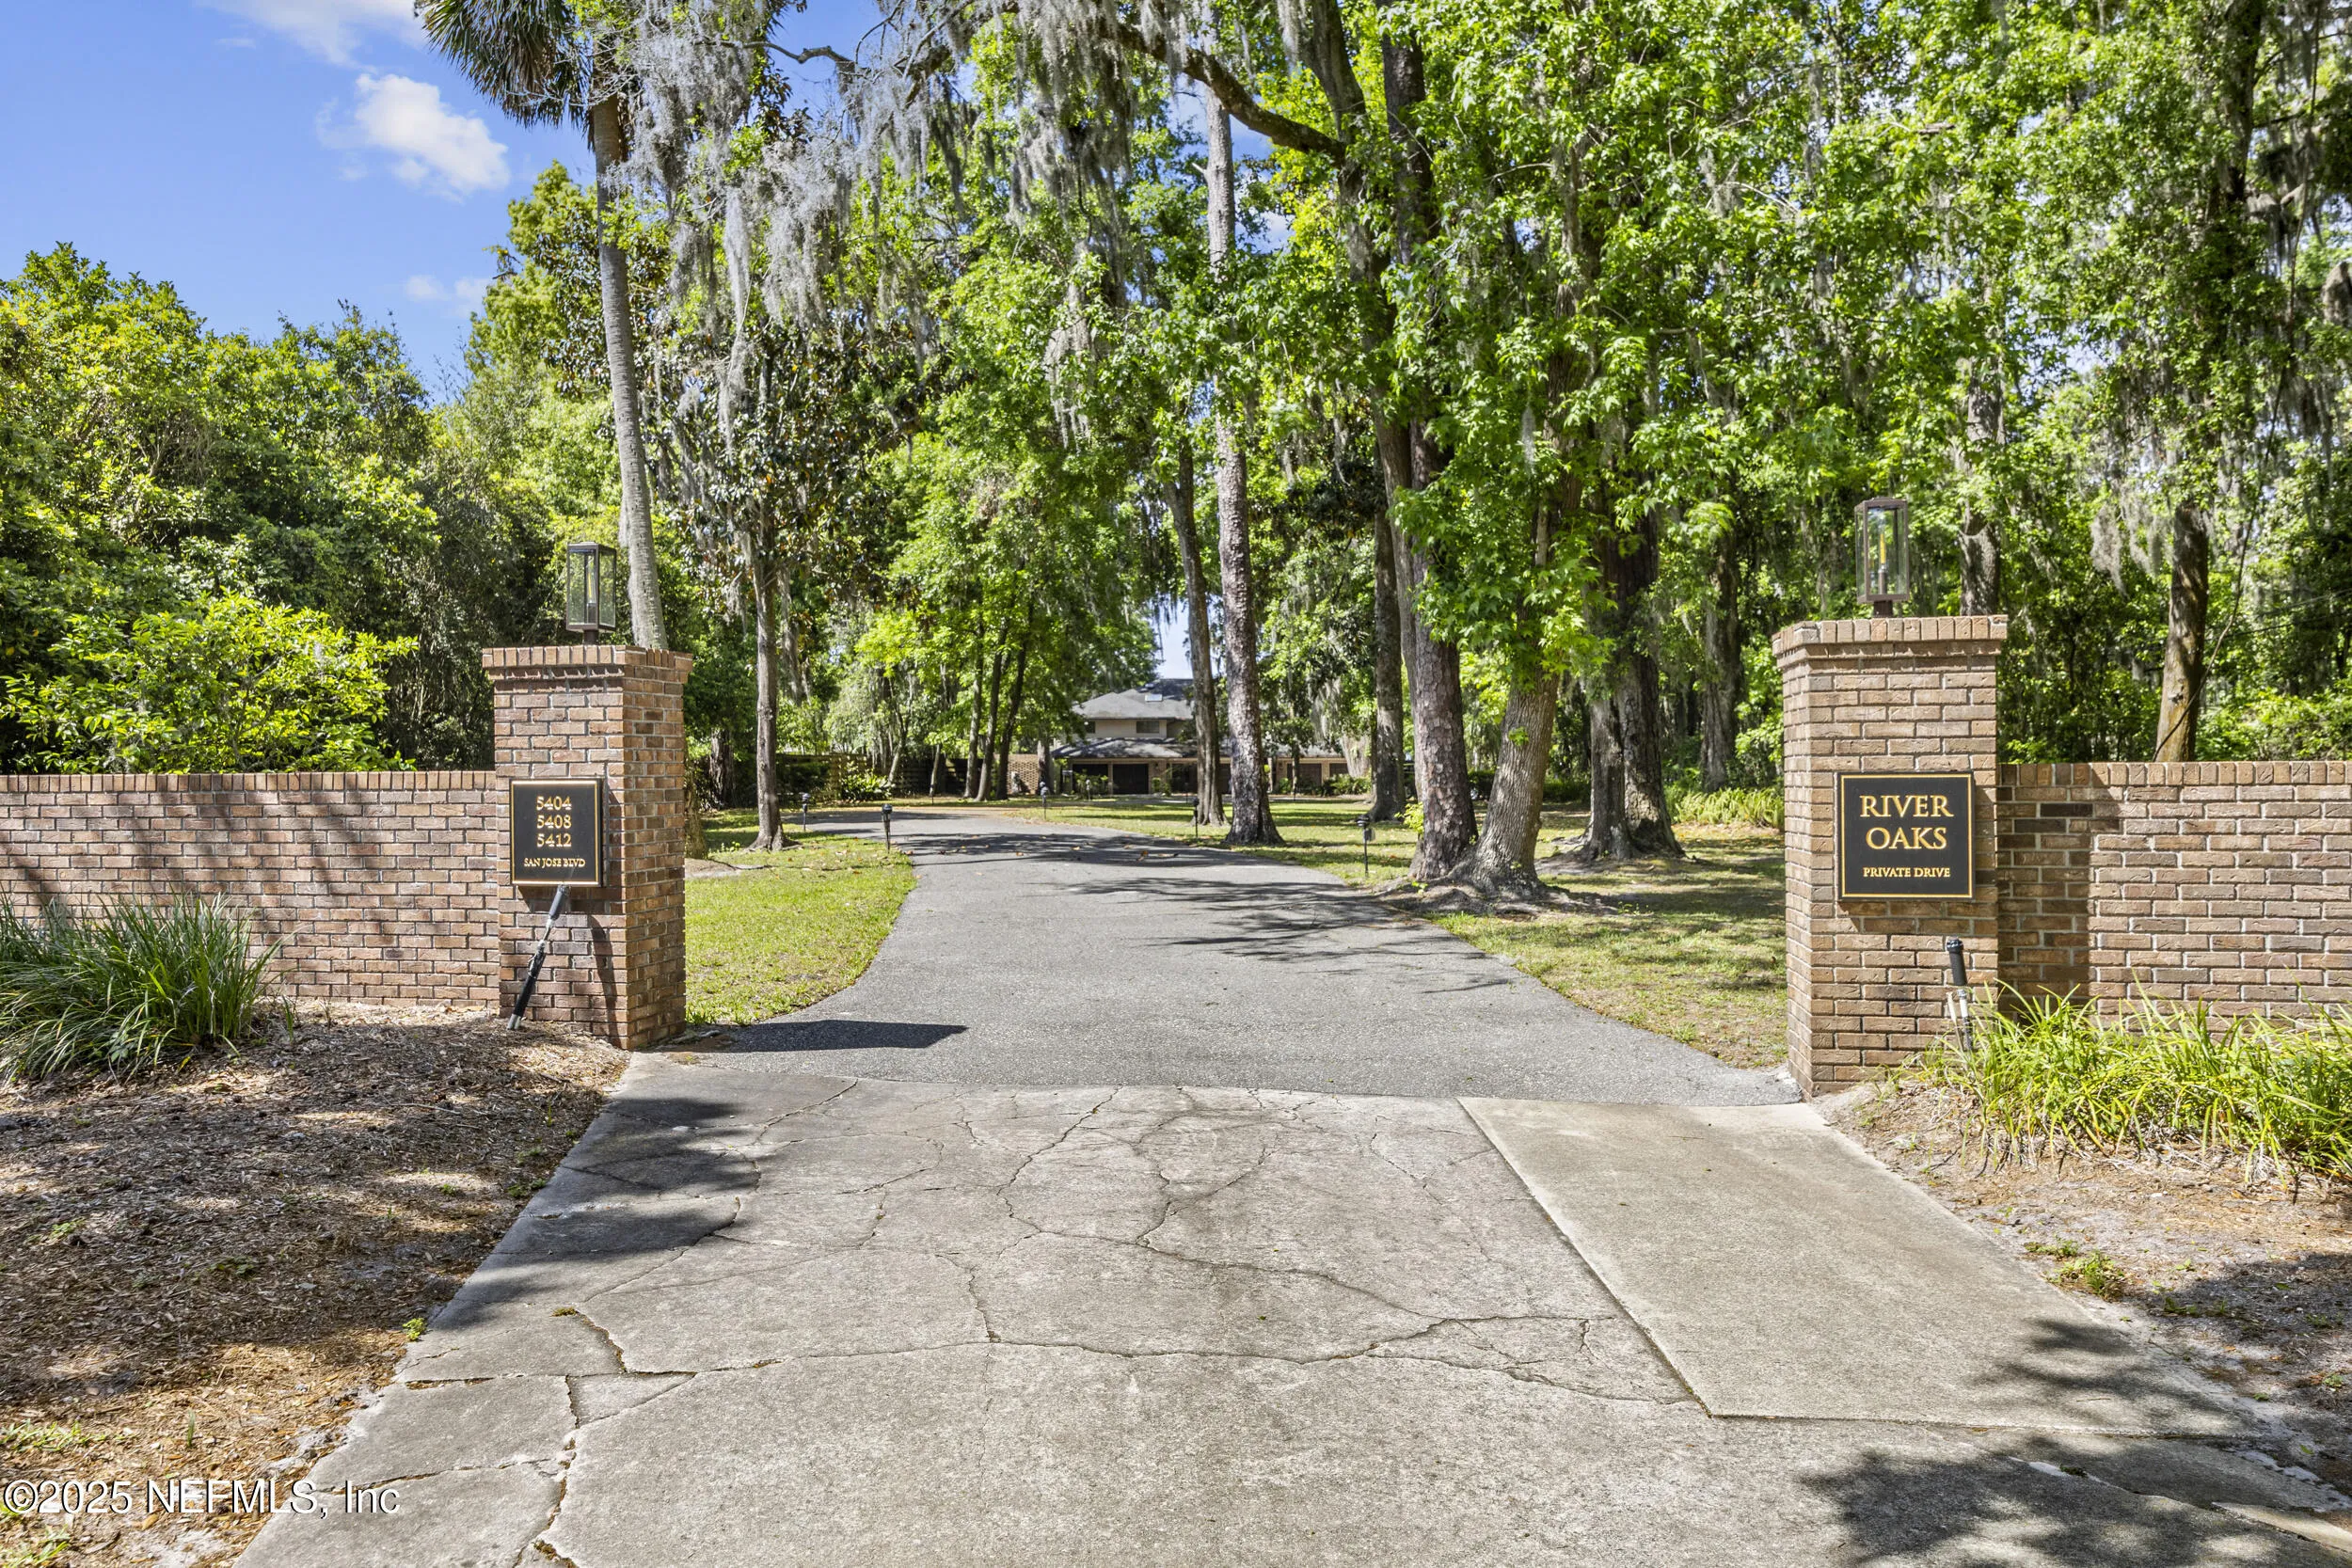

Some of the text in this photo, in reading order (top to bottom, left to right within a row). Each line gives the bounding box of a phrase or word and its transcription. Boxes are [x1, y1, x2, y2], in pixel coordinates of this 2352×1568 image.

[535, 796, 572, 811] 5404
[1859, 795, 1955, 817] RIVER
[536, 815, 572, 829] 5408
[536, 833, 572, 847] 5412
[1866, 827, 1947, 850] OAKS
[523, 858, 586, 868] SAN JOSE BLVD
[1863, 867, 1951, 878] PRIVATE DRIVE
